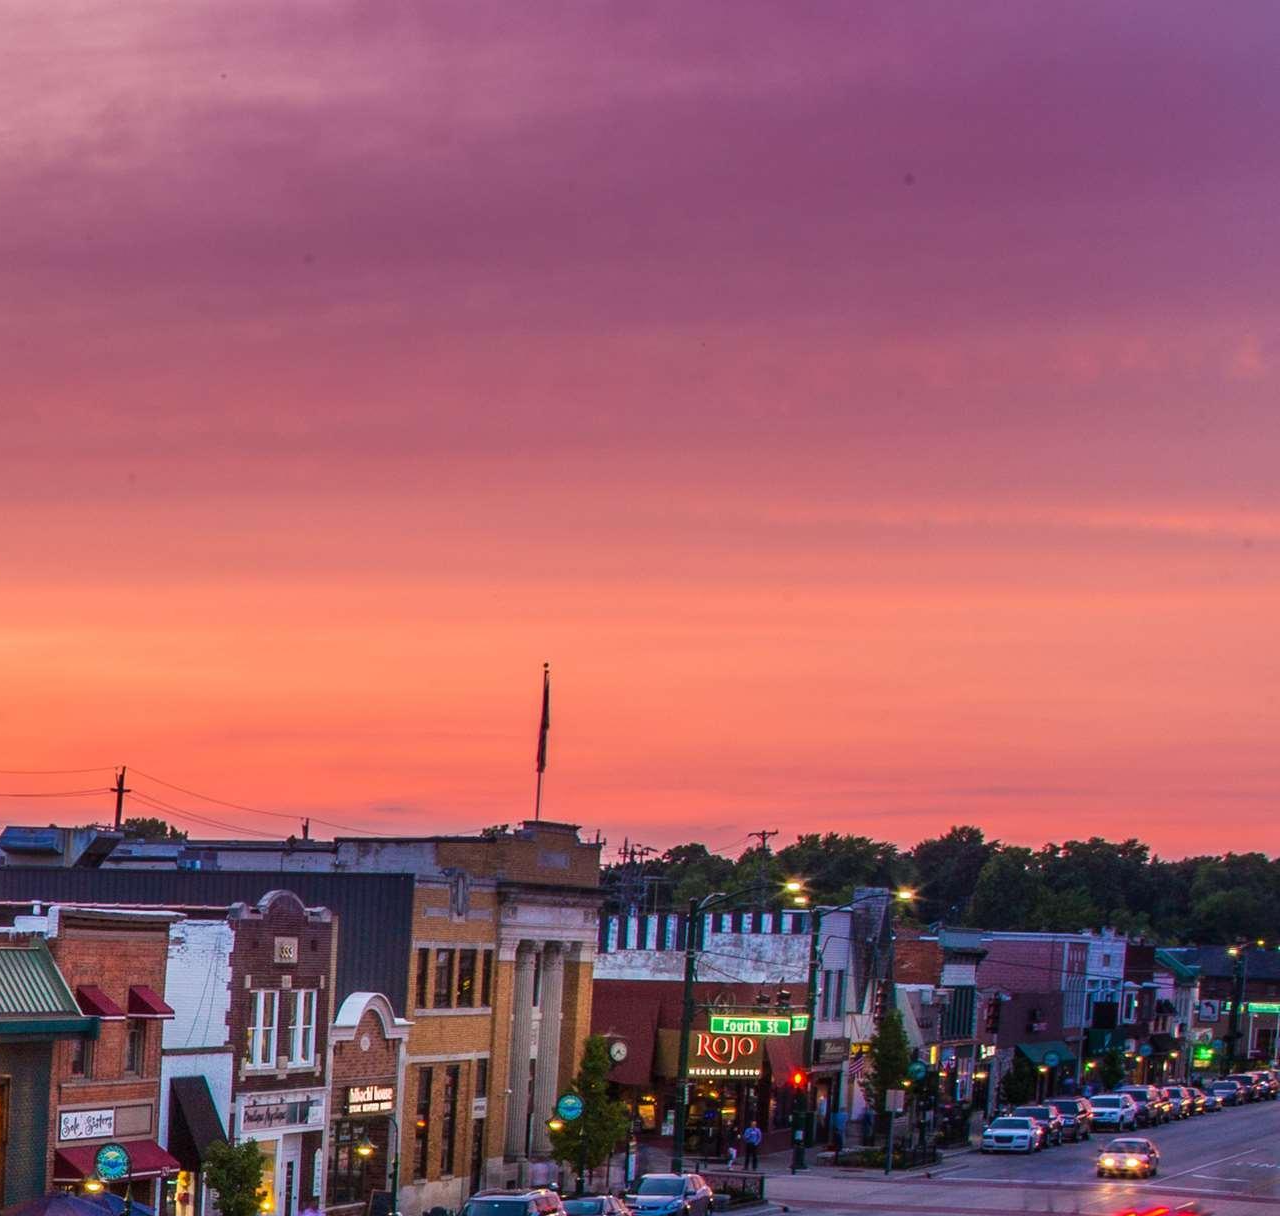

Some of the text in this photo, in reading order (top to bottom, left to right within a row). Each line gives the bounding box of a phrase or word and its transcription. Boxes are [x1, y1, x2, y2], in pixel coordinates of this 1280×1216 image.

[723, 1020, 778, 1033] Fourth St
[696, 1034, 756, 1065] ROJO
